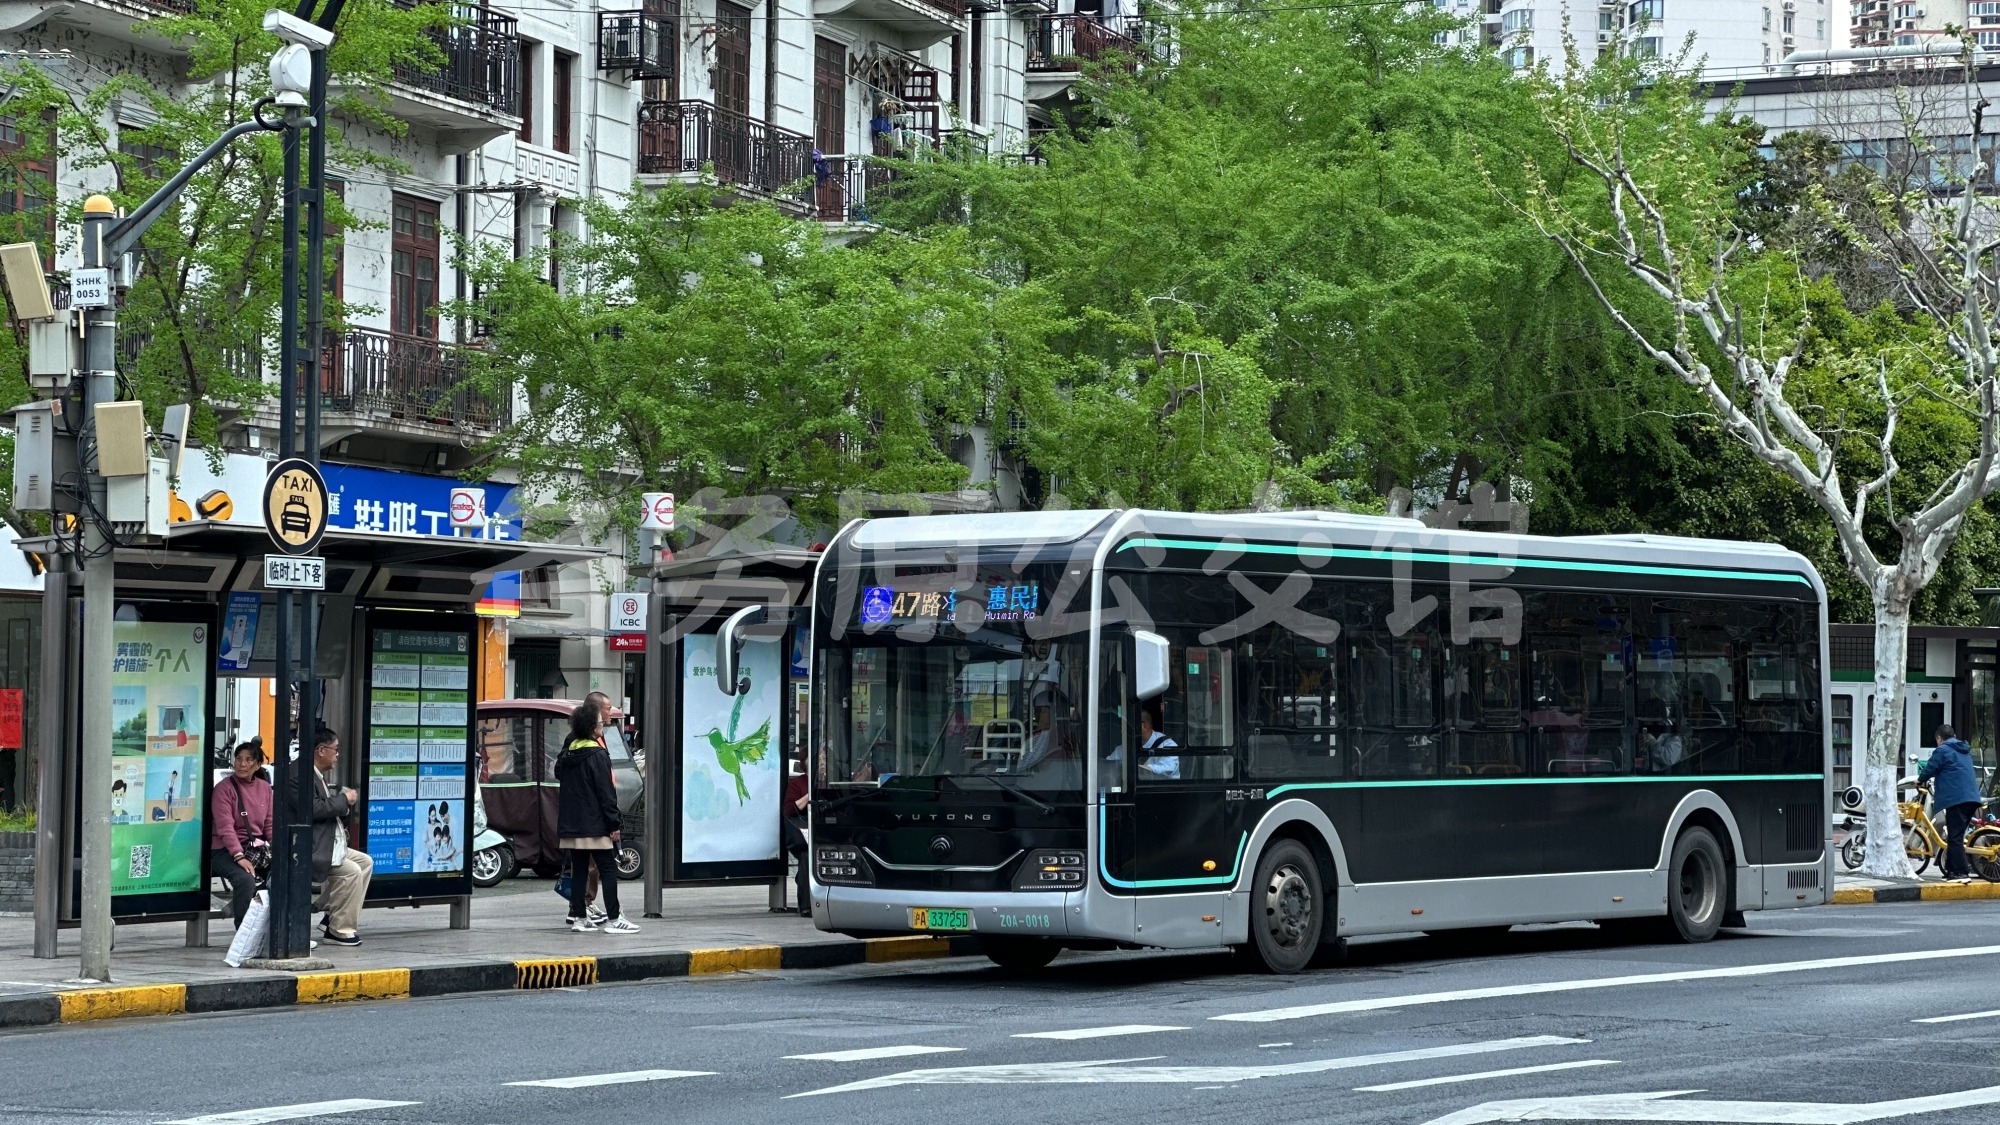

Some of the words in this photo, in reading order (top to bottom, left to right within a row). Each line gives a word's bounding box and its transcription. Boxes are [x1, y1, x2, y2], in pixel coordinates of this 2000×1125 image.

[76, 277, 102, 285] SHHK
[76, 289, 100, 298] 0053
[282, 474, 313, 492] TAXI
[291, 495, 304, 503] TAXI
[268, 560, 322, 583] 临时上下客
[891, 592, 941, 617] 47路
[984, 610, 1019, 620] Huimin
[620, 618, 641, 627] ICBC
[615, 638, 629, 647] 24h
[117, 642, 153, 657] 雾霾的
[154, 648, 191, 673] 个人
[895, 813, 992, 821] YUTONG
[931, 911, 968, 927] 33725D
